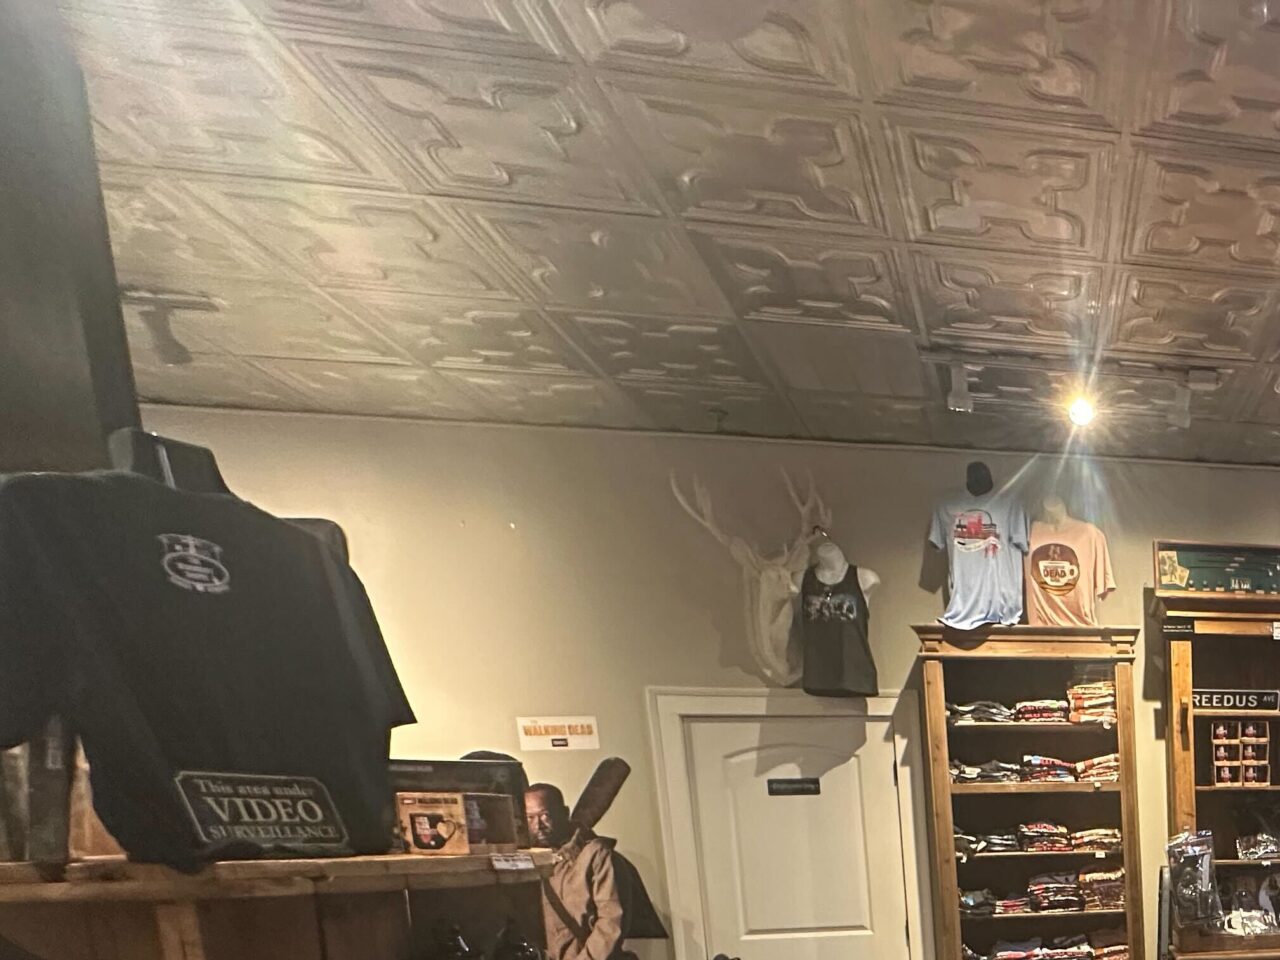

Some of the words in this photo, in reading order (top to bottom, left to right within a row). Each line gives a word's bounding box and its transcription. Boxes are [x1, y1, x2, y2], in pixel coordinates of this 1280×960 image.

[1043, 568, 1066, 578] DEAD
[1192, 694, 1258, 707] REEDUS
[193, 779, 233, 793] This
[202, 796, 324, 822] VIDEO
[209, 825, 340, 840] SURVEILLANCE
